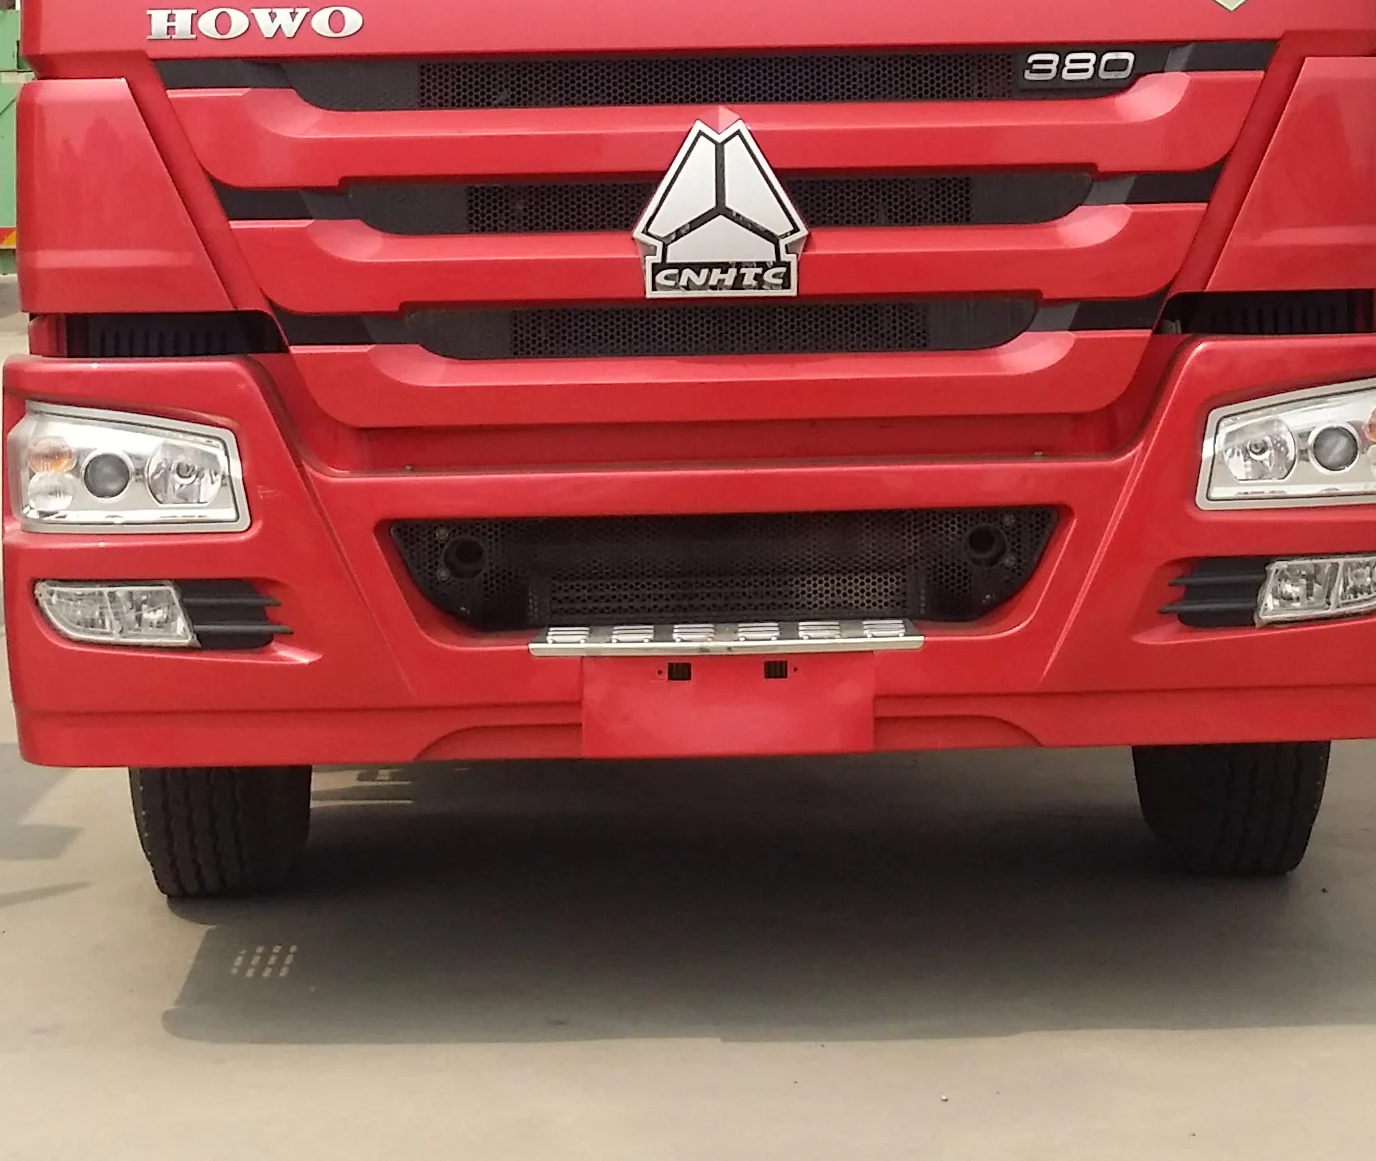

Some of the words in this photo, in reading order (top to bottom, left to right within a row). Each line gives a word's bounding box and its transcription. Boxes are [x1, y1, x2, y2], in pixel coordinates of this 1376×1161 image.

[146, 6, 364, 40] HOWO
[1024, 51, 1135, 80] 380
[655, 267, 787, 290] CNHTC
